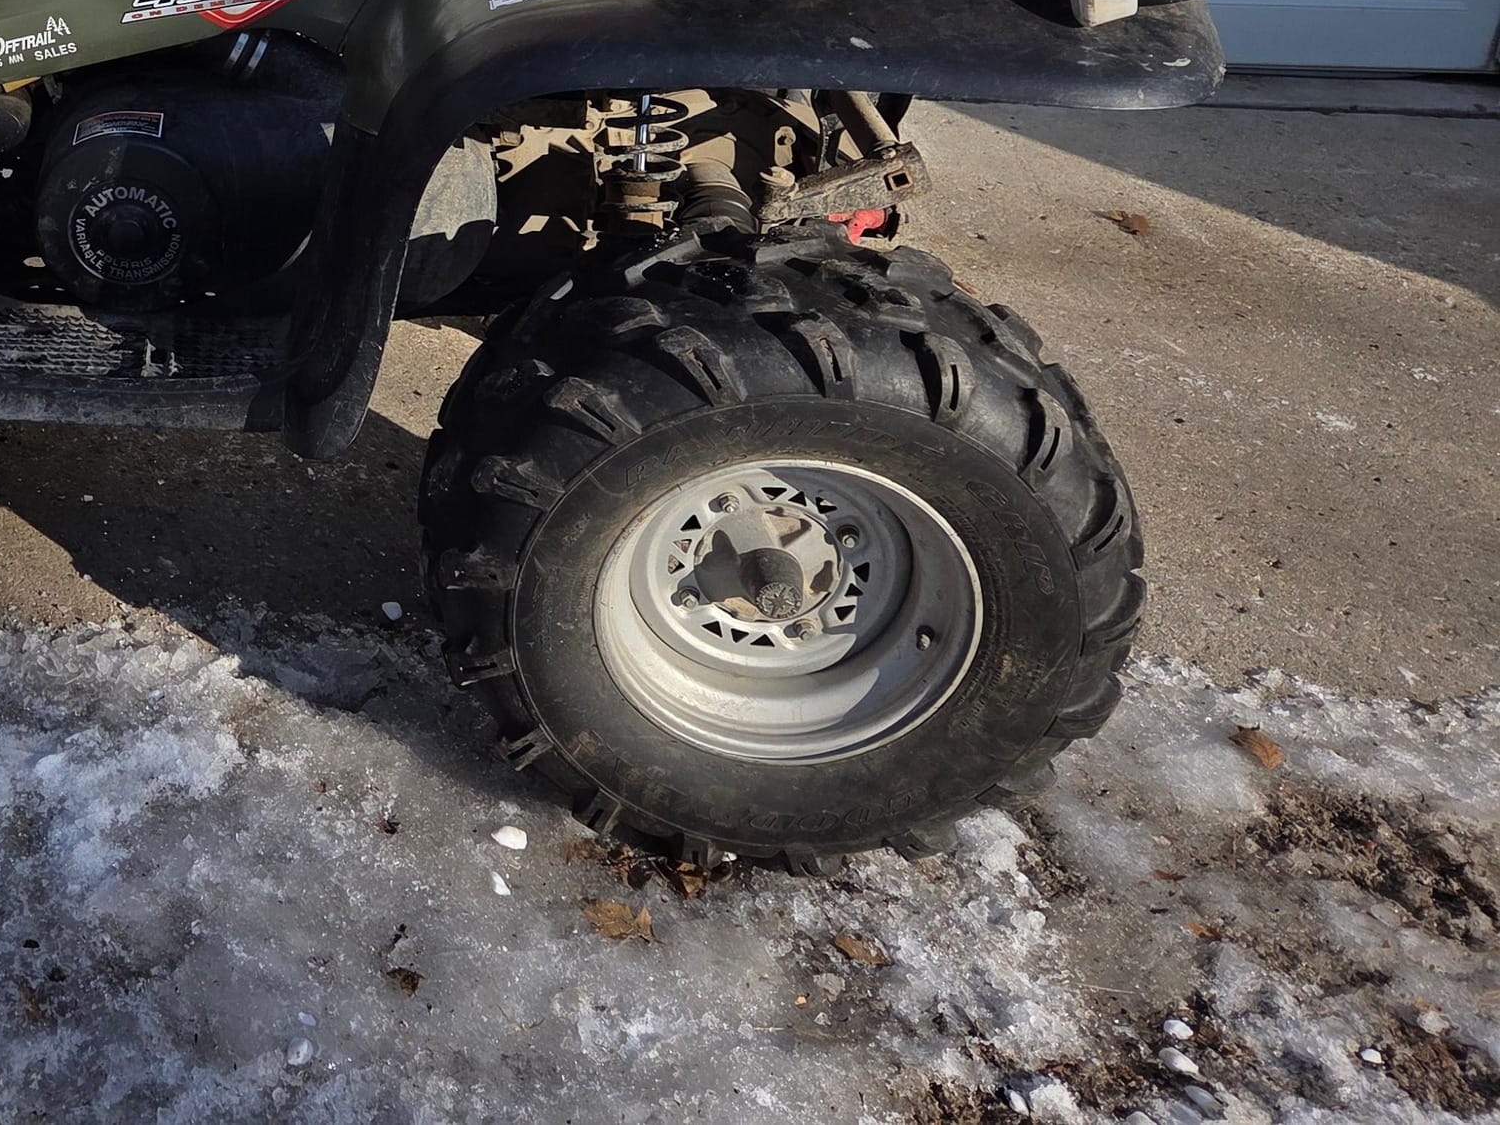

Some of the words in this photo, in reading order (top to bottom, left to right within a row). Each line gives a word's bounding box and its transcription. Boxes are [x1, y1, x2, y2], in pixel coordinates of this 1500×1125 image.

[131, 9, 162, 20] ON
[8, 53, 24, 65] MN
[34, 42, 78, 61] SALES
[84, 186, 178, 230] AUTOMATIC
[75, 218, 106, 270] VARIABLE
[109, 233, 181, 279] TRANSMISSION
[96, 249, 153, 269] POLARIS
